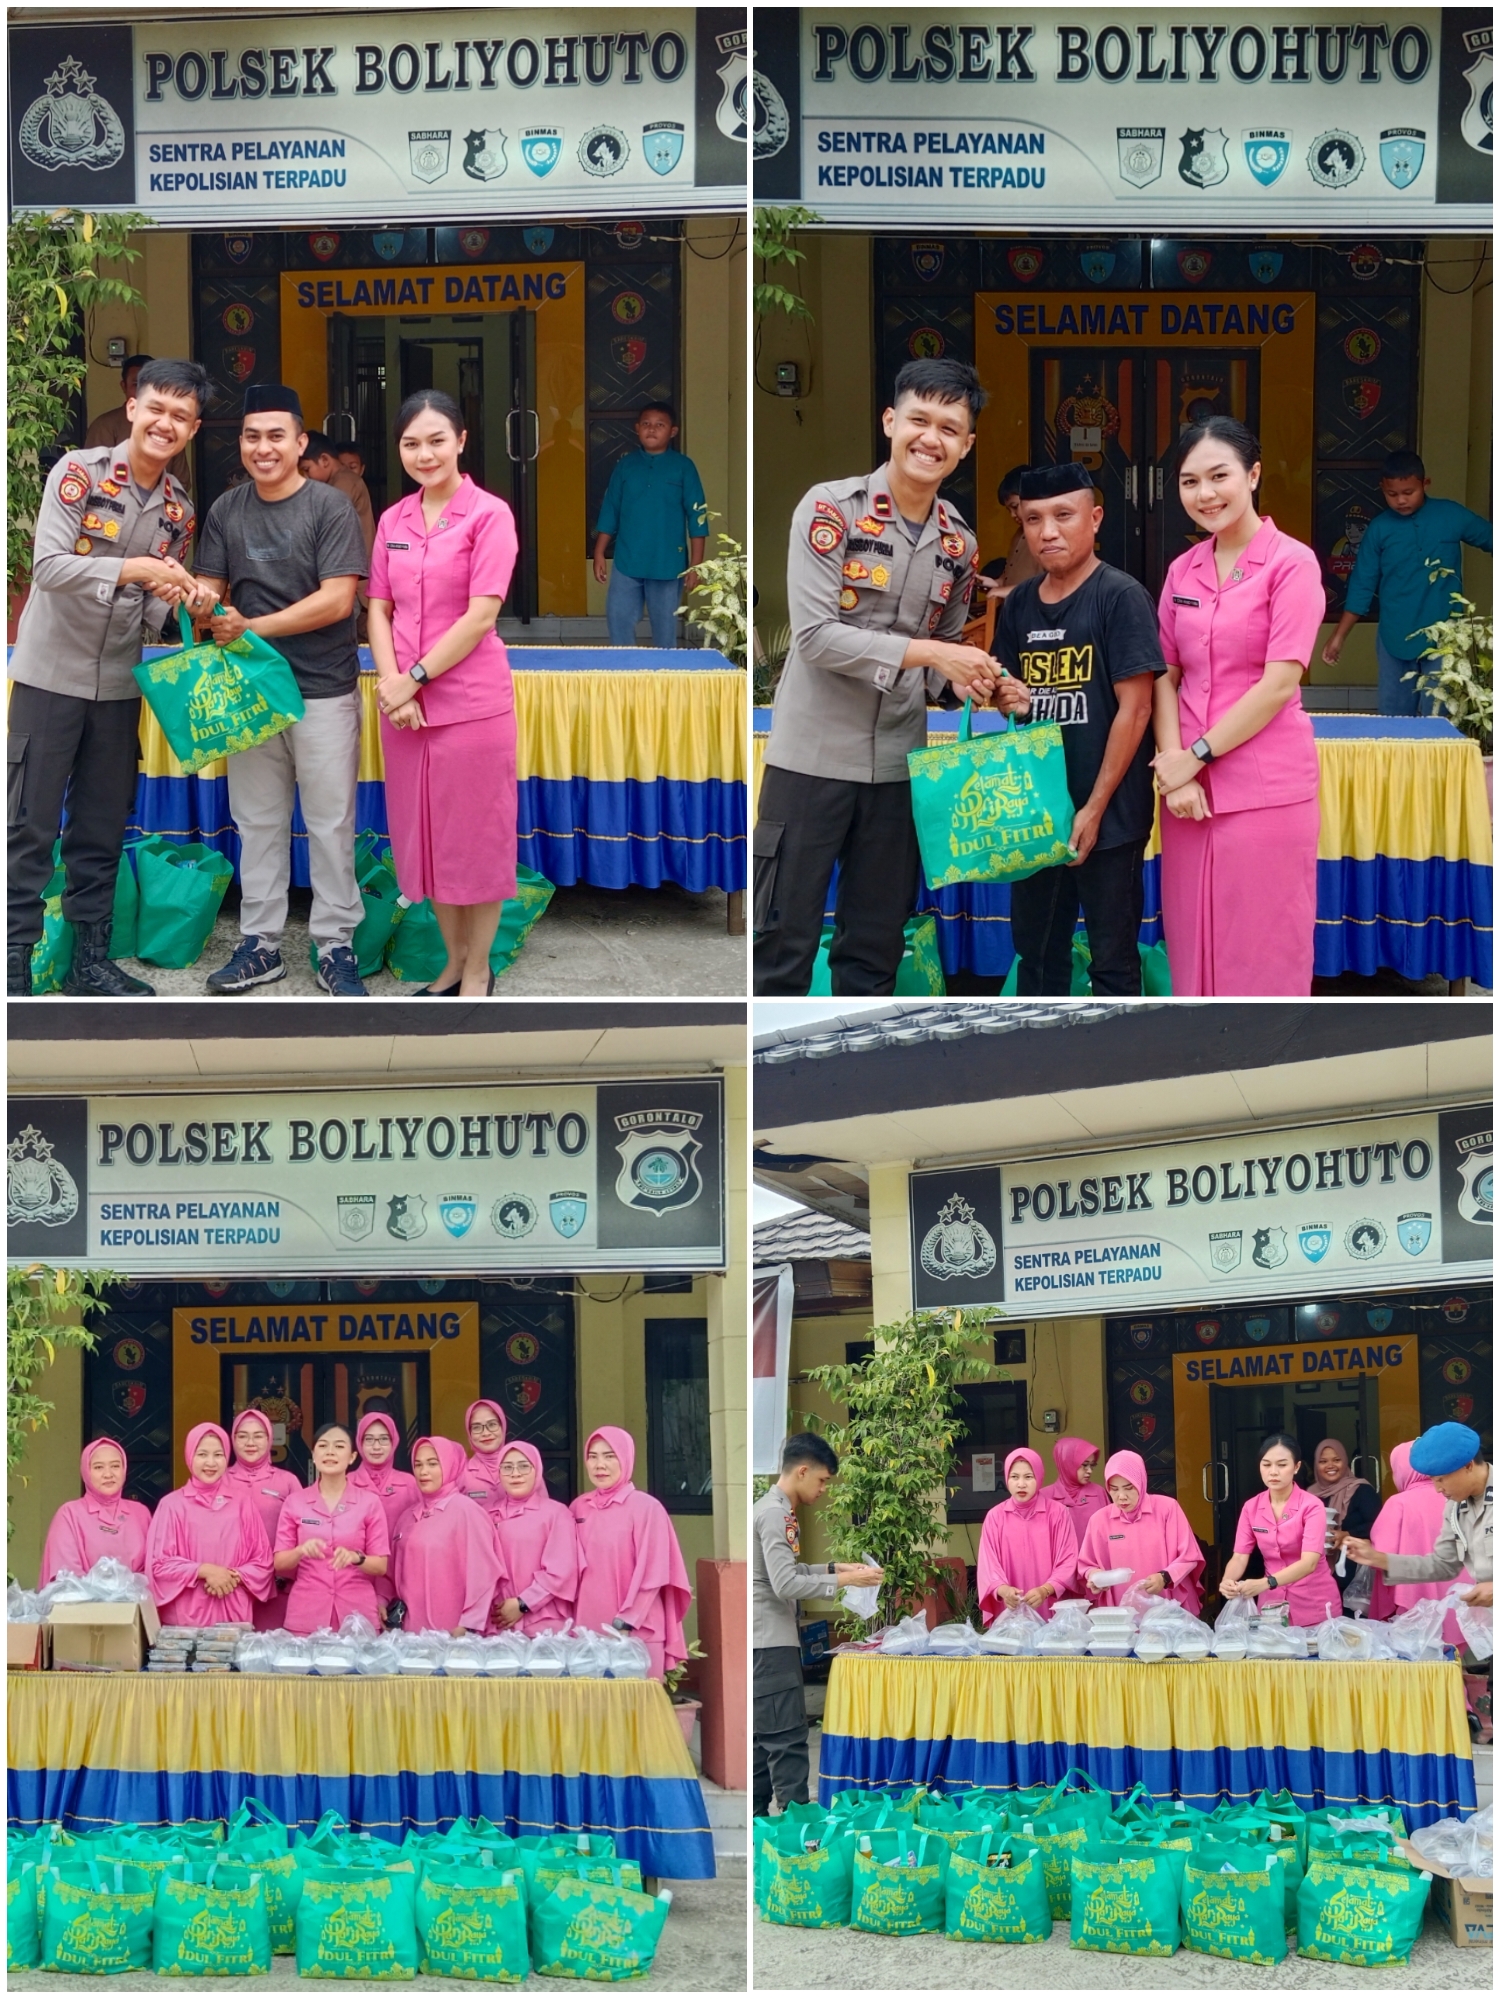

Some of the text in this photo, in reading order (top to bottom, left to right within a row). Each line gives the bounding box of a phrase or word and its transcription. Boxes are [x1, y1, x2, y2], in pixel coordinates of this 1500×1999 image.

[812, 22, 1431, 84] POLSEK BOLIYOHUTO
[144, 30, 687, 101] POLSEK BOLIYOHUTO
[411, 131, 449, 140] SABHARA
[525, 128, 557, 137] BINMAS
[817, 131, 1045, 154] SENTRA PELAYANAN
[1119, 129, 1163, 138] SABHARA
[1249, 131, 1285, 139] BINMAS
[149, 139, 345, 162] SENTRA PELAYANAN
[150, 169, 346, 191] KEPOLISIAN TERPADU
[818, 165, 1046, 189] KEPOLISIAN TERPADU
[297, 272, 566, 308] SELAMAT DATANG
[995, 304, 1295, 335] SELAMAT DATANG
[1019, 645, 1093, 687] OSLEM
[620, 1112, 696, 1127] GORONTALO
[97, 1111, 590, 1166] POLSEK BOLIYOHUTO
[1009, 1138, 1432, 1224] POLSEK BOLIYOHUTO
[100, 1201, 280, 1220] SENTRA PELAYANAN
[100, 1227, 281, 1246] KEPOLISIAN TERPADU
[1210, 1231, 1241, 1240] SABHARA
[1301, 1223, 1328, 1231] BINMAS
[1014, 1242, 1161, 1270] SENTRA PELAYANAN
[1015, 1265, 1162, 1292] KEPOLISIAN TERPADU
[190, 1312, 460, 1344] SELAMAT DATANG
[1186, 1344, 1403, 1382] SELAMAT DATANG
